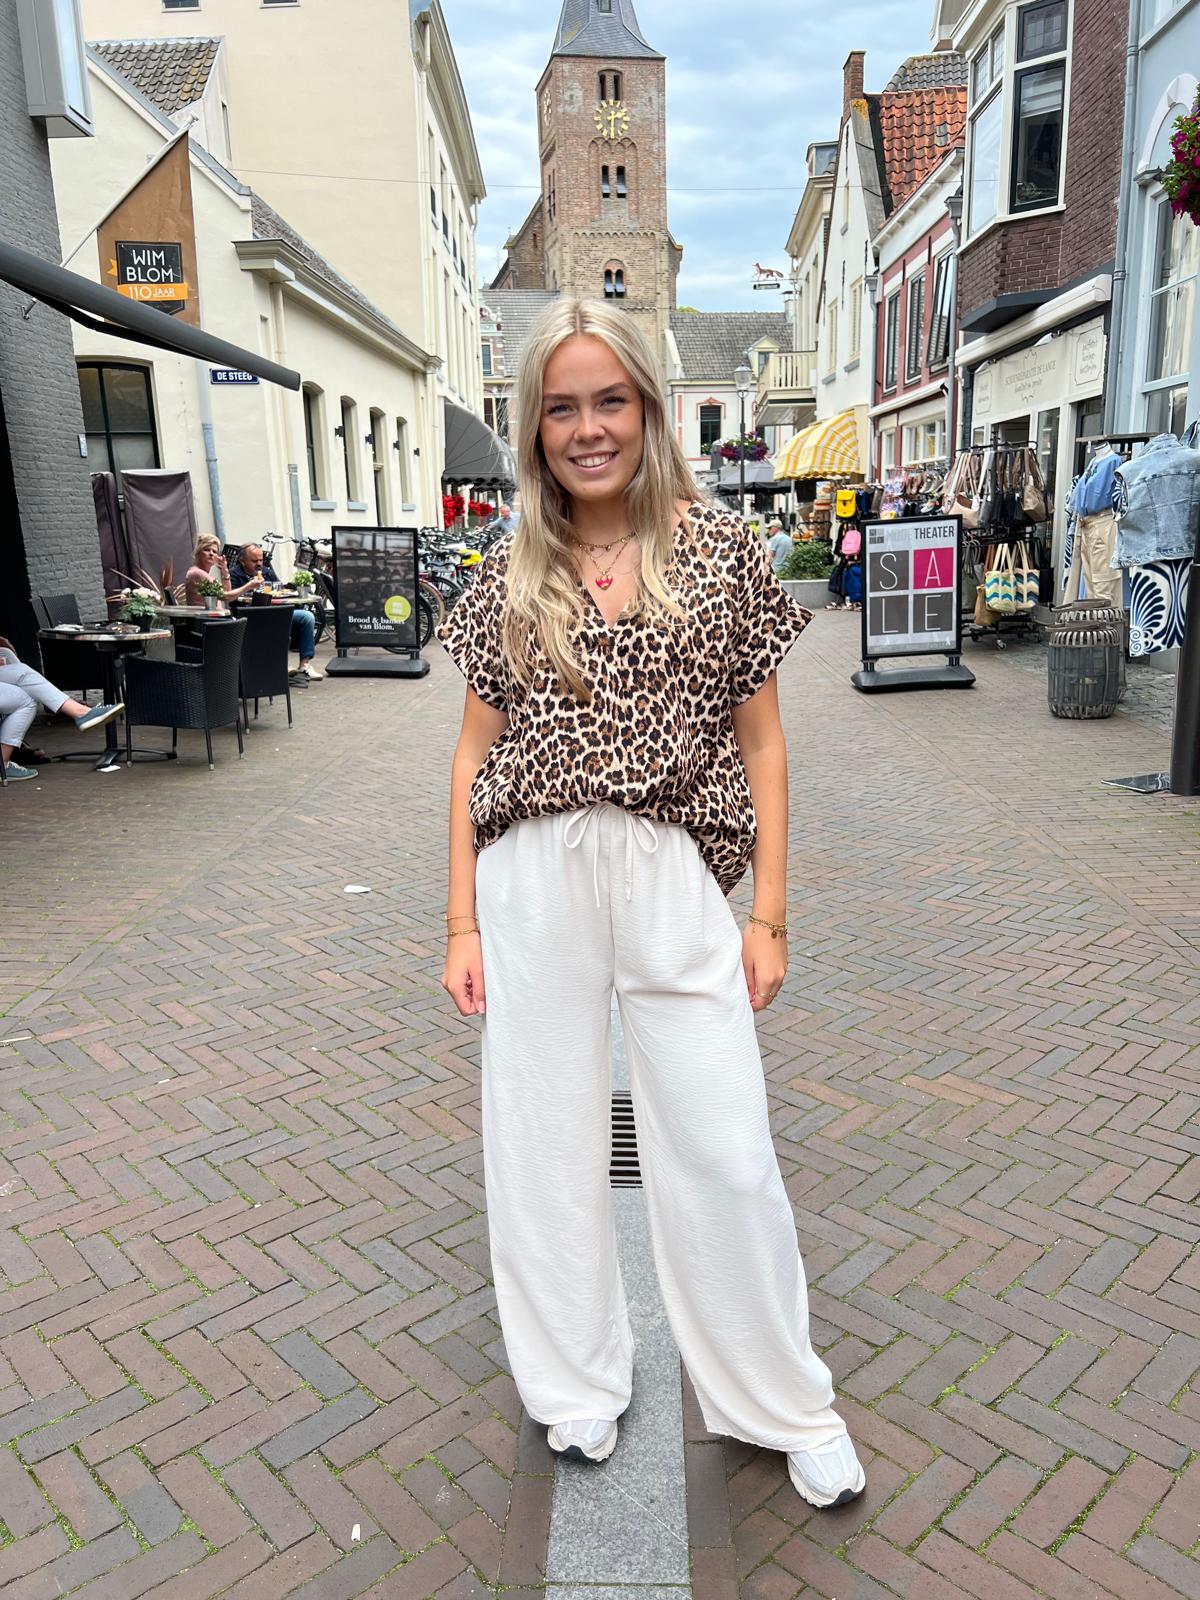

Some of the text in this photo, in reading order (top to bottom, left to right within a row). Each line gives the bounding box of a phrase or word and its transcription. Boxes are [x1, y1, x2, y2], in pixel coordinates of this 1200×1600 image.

[132, 249, 165, 266] WIM
[126, 266, 174, 283] BLOM
[129, 286, 175, 299] 110 JAAR
[217, 372, 227, 381] DE
[914, 525, 955, 539] THEATER
[348, 616, 370, 624] Brood
